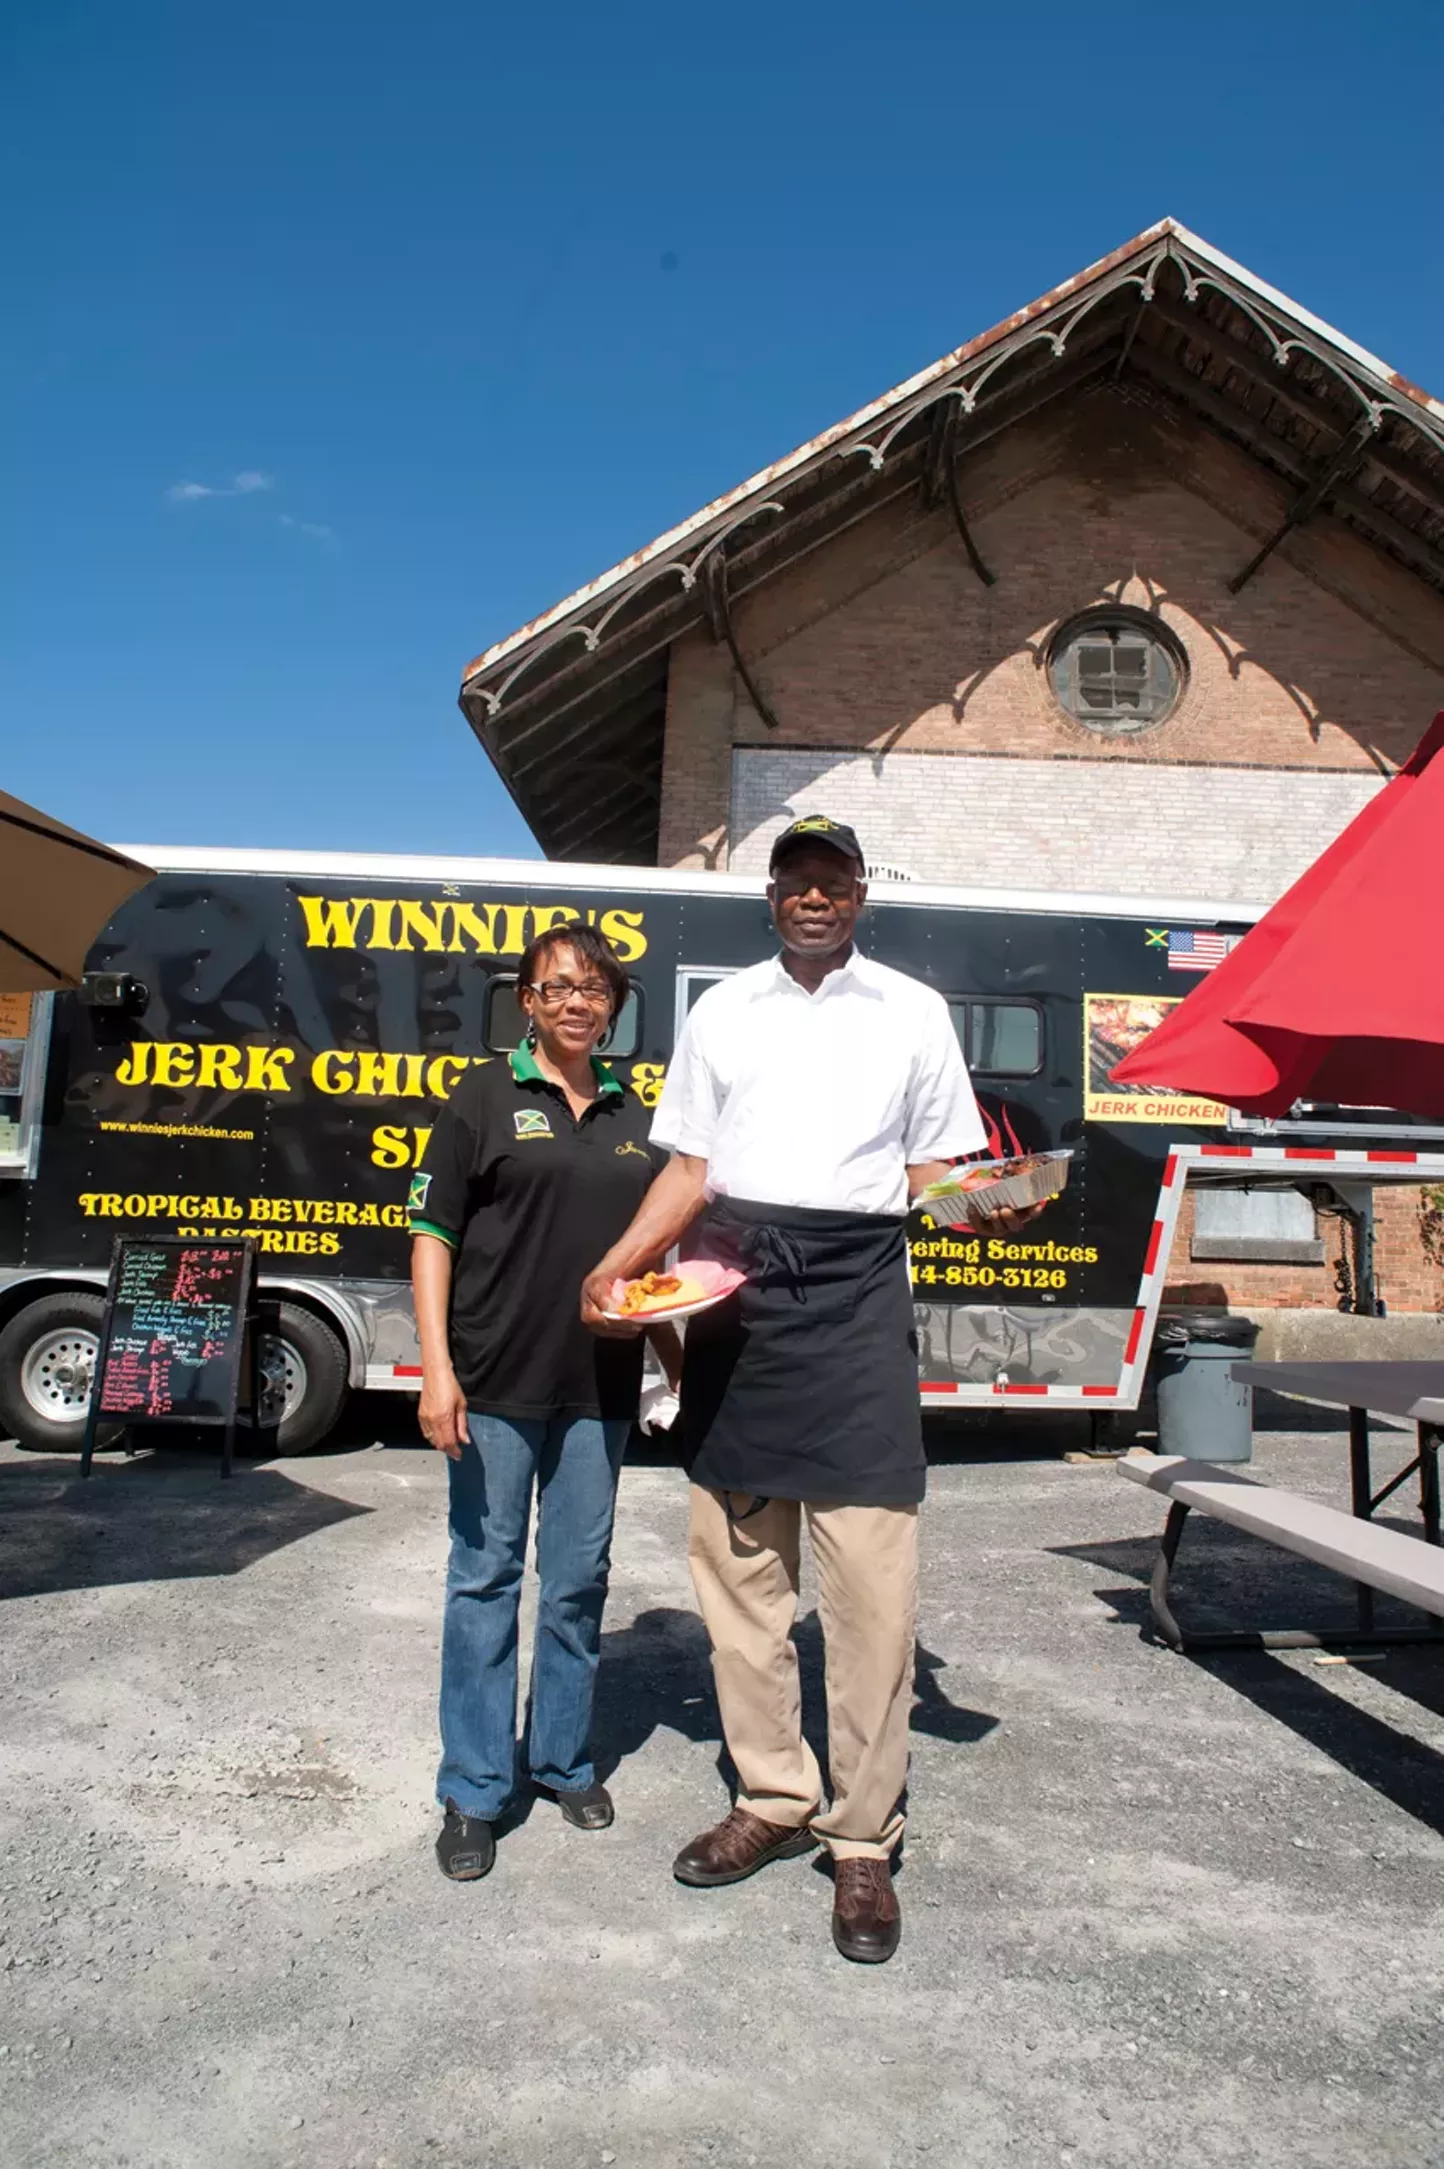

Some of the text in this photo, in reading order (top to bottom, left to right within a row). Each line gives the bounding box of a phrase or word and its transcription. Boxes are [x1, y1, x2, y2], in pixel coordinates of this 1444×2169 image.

[115, 1041, 295, 1092] JERK
[311, 1050, 496, 1100] CHIC
[1089, 1101, 1226, 1118] JERK CHICKEN
[100, 1120, 254, 1141] www.winniesjerkchicken.com
[79, 1193, 410, 1227] TROPICAL BEVERAG
[908, 1237, 1099, 1264] ering Services
[911, 1265, 1067, 1288] 14-850-3126
